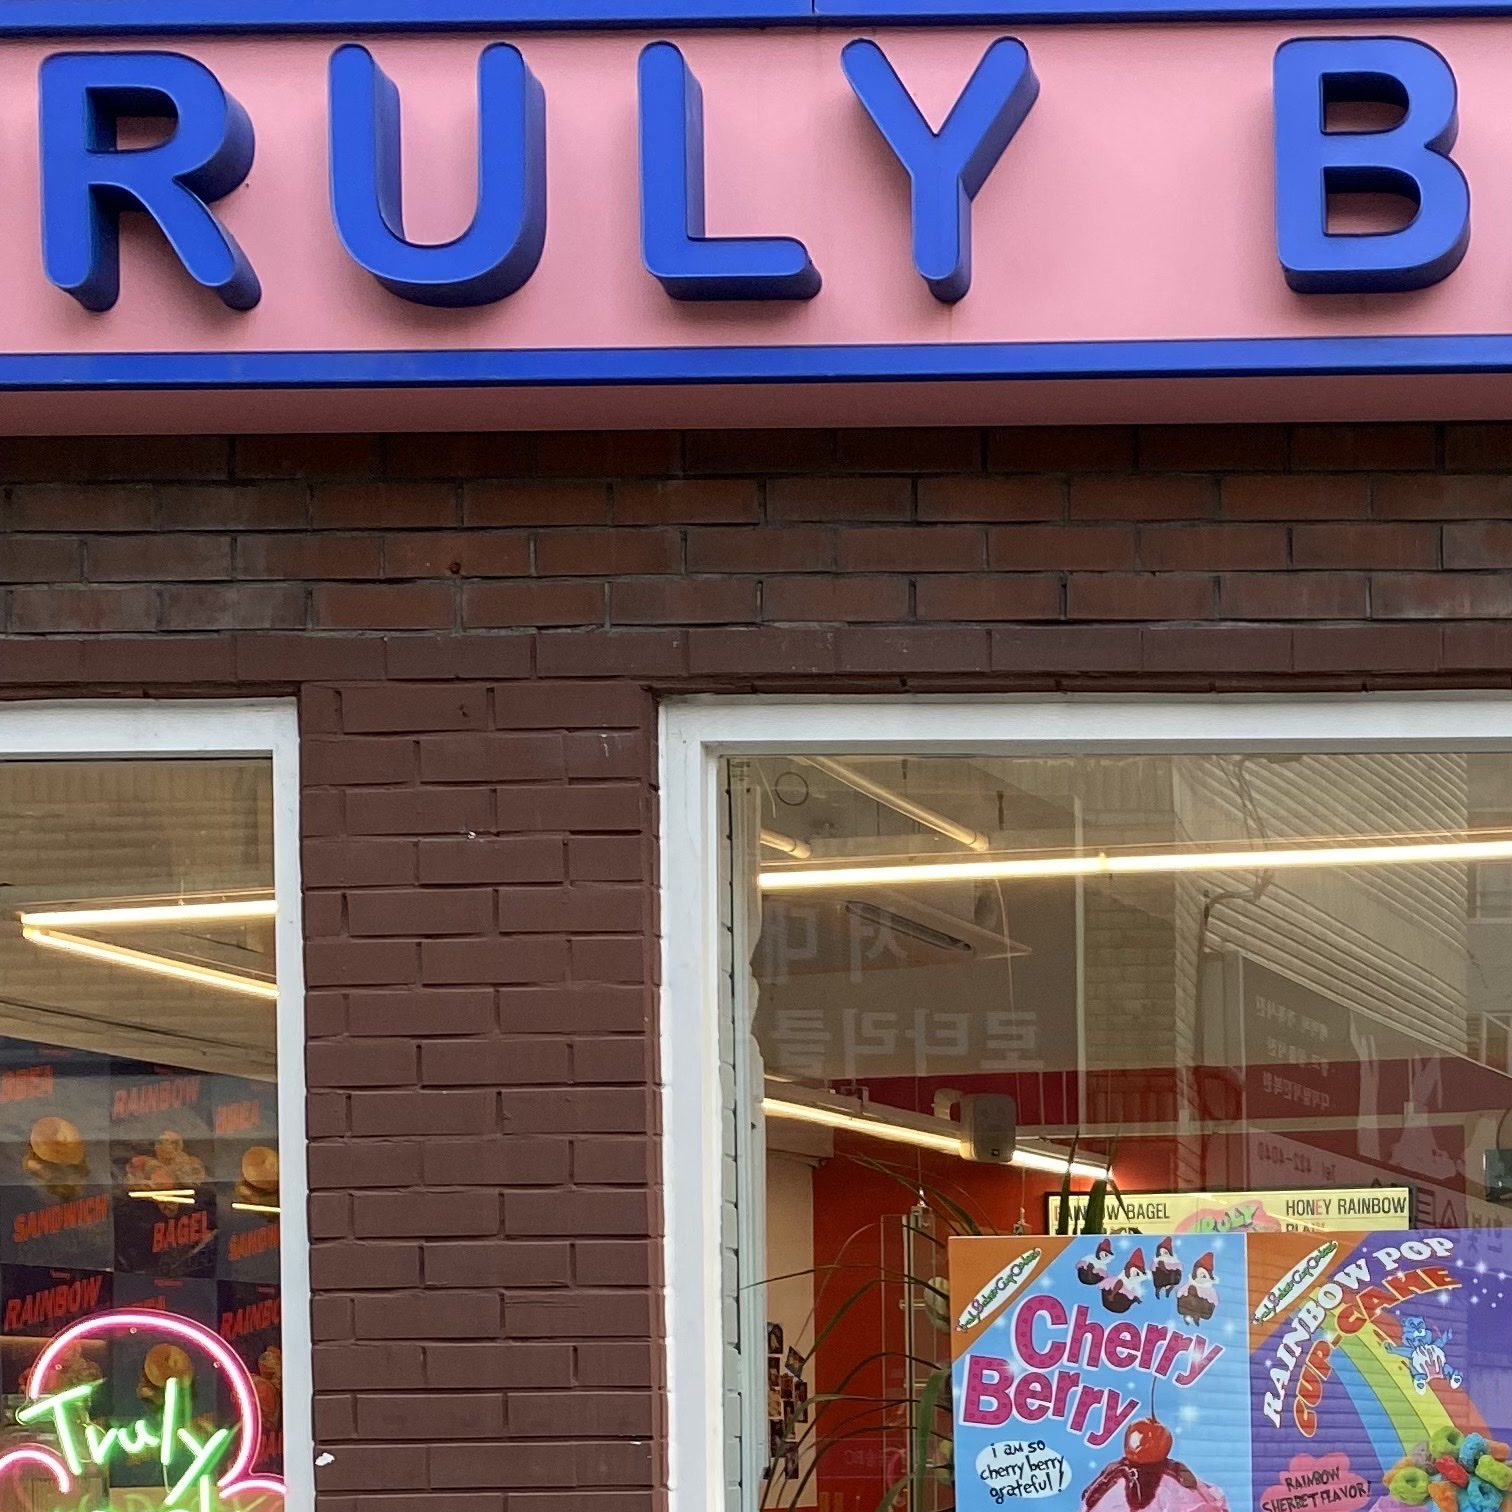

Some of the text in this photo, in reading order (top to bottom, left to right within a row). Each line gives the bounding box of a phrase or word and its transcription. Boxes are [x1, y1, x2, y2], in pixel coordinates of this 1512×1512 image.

[38, 40, 1040, 312] RULY
[1126, 1203, 1170, 1220] BAGEL
[1286, 1198, 1331, 1216] HONEY
[1338, 1196, 1407, 1215] RAINBOW
[152, 1211, 215, 1253] BAGEL
[5, 1276, 103, 1332] RAINBOW
[1013, 1294, 1223, 1386] Cherry
[1264, 1237, 1454, 1428] RAINBOW POP
[962, 1354, 1140, 1447] Berry
[16, 1376, 230, 1506] Truly
[1028, 1440, 1045, 1453] so
[980, 1455, 1064, 1480] cherry berry
[1284, 1466, 1340, 1492] RAINBOW
[1320, 1480, 1372, 1505] FLAVOR!
